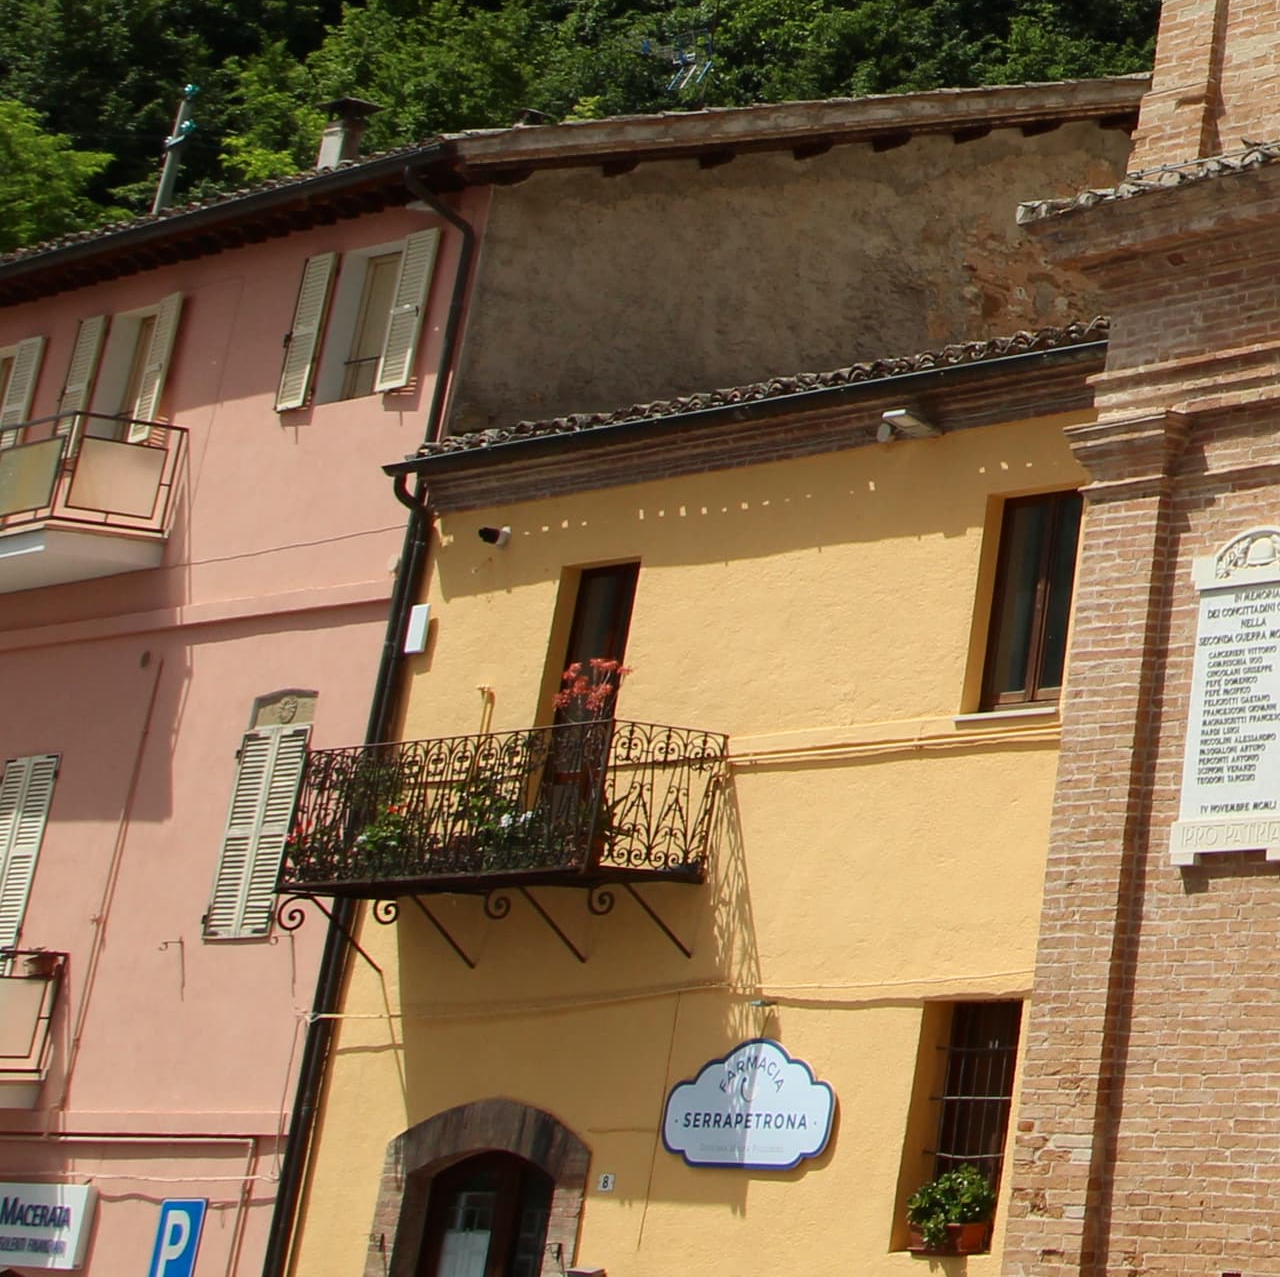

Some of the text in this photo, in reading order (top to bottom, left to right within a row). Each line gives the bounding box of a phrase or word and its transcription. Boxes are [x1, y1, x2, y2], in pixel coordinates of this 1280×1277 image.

[719, 1055, 785, 1093] FARMACIA
[683, 1112, 808, 1130] SERRAPETRONA
[602, 1175, 610, 1189] 8
[0, 1196, 71, 1228] MACERATA
[158, 1210, 191, 1277] P
